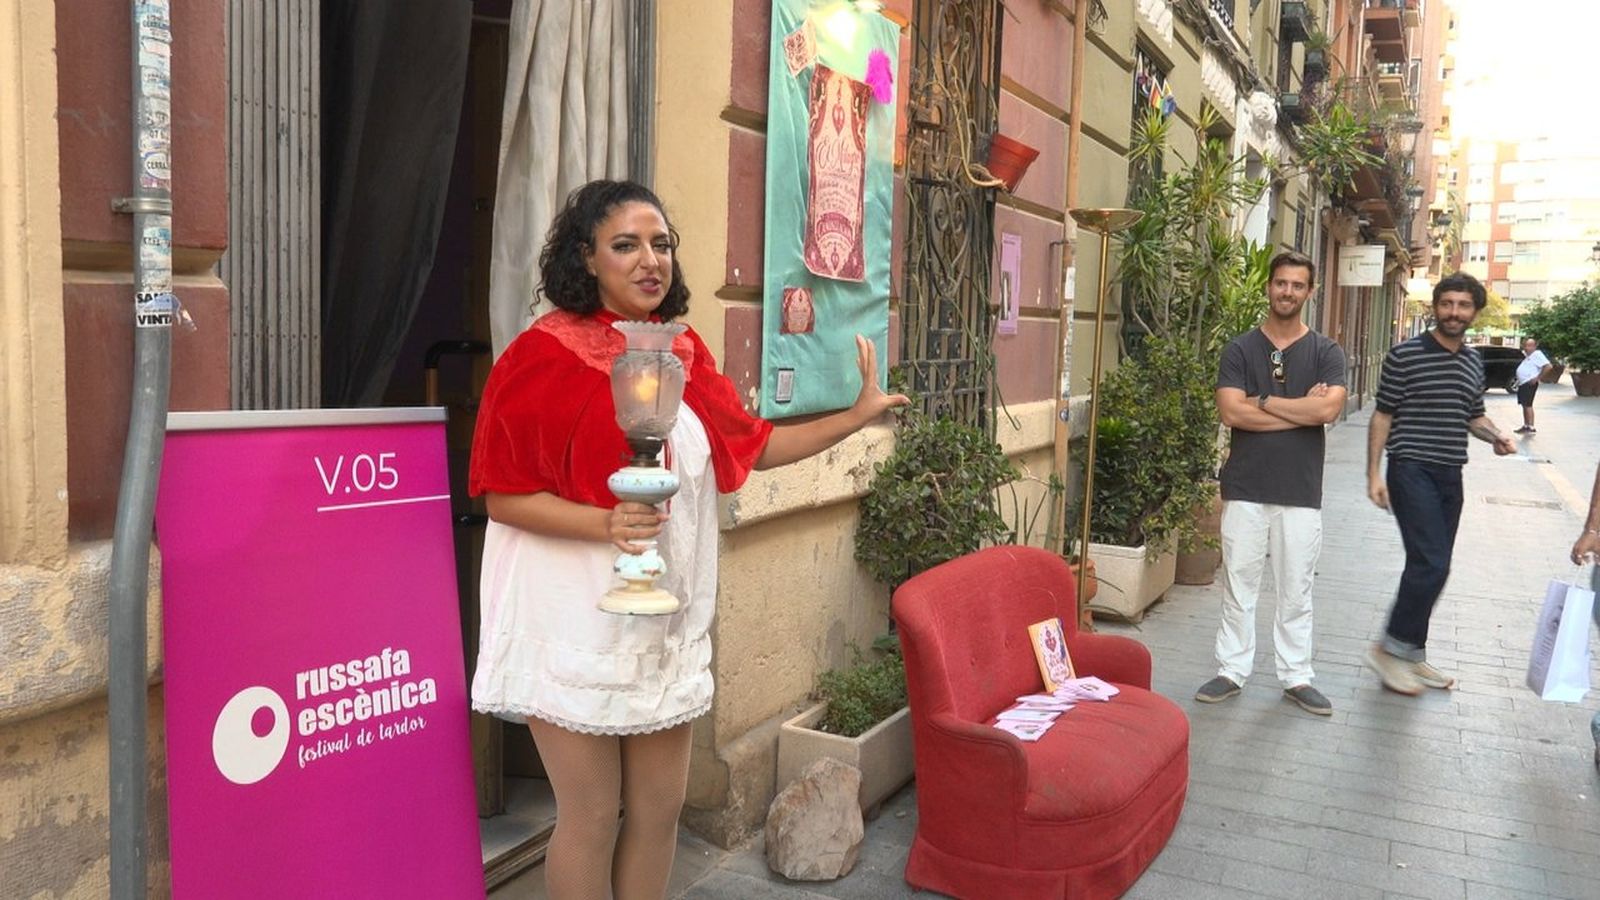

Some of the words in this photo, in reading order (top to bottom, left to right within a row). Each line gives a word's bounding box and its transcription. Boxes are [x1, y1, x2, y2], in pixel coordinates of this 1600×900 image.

[314, 452, 399, 495] V.05
[295, 647, 411, 700] russafa
[298, 678, 437, 736] escènica
[298, 733, 352, 769] festival
[356, 728, 375, 746] de
[379, 715, 427, 740] tardor
